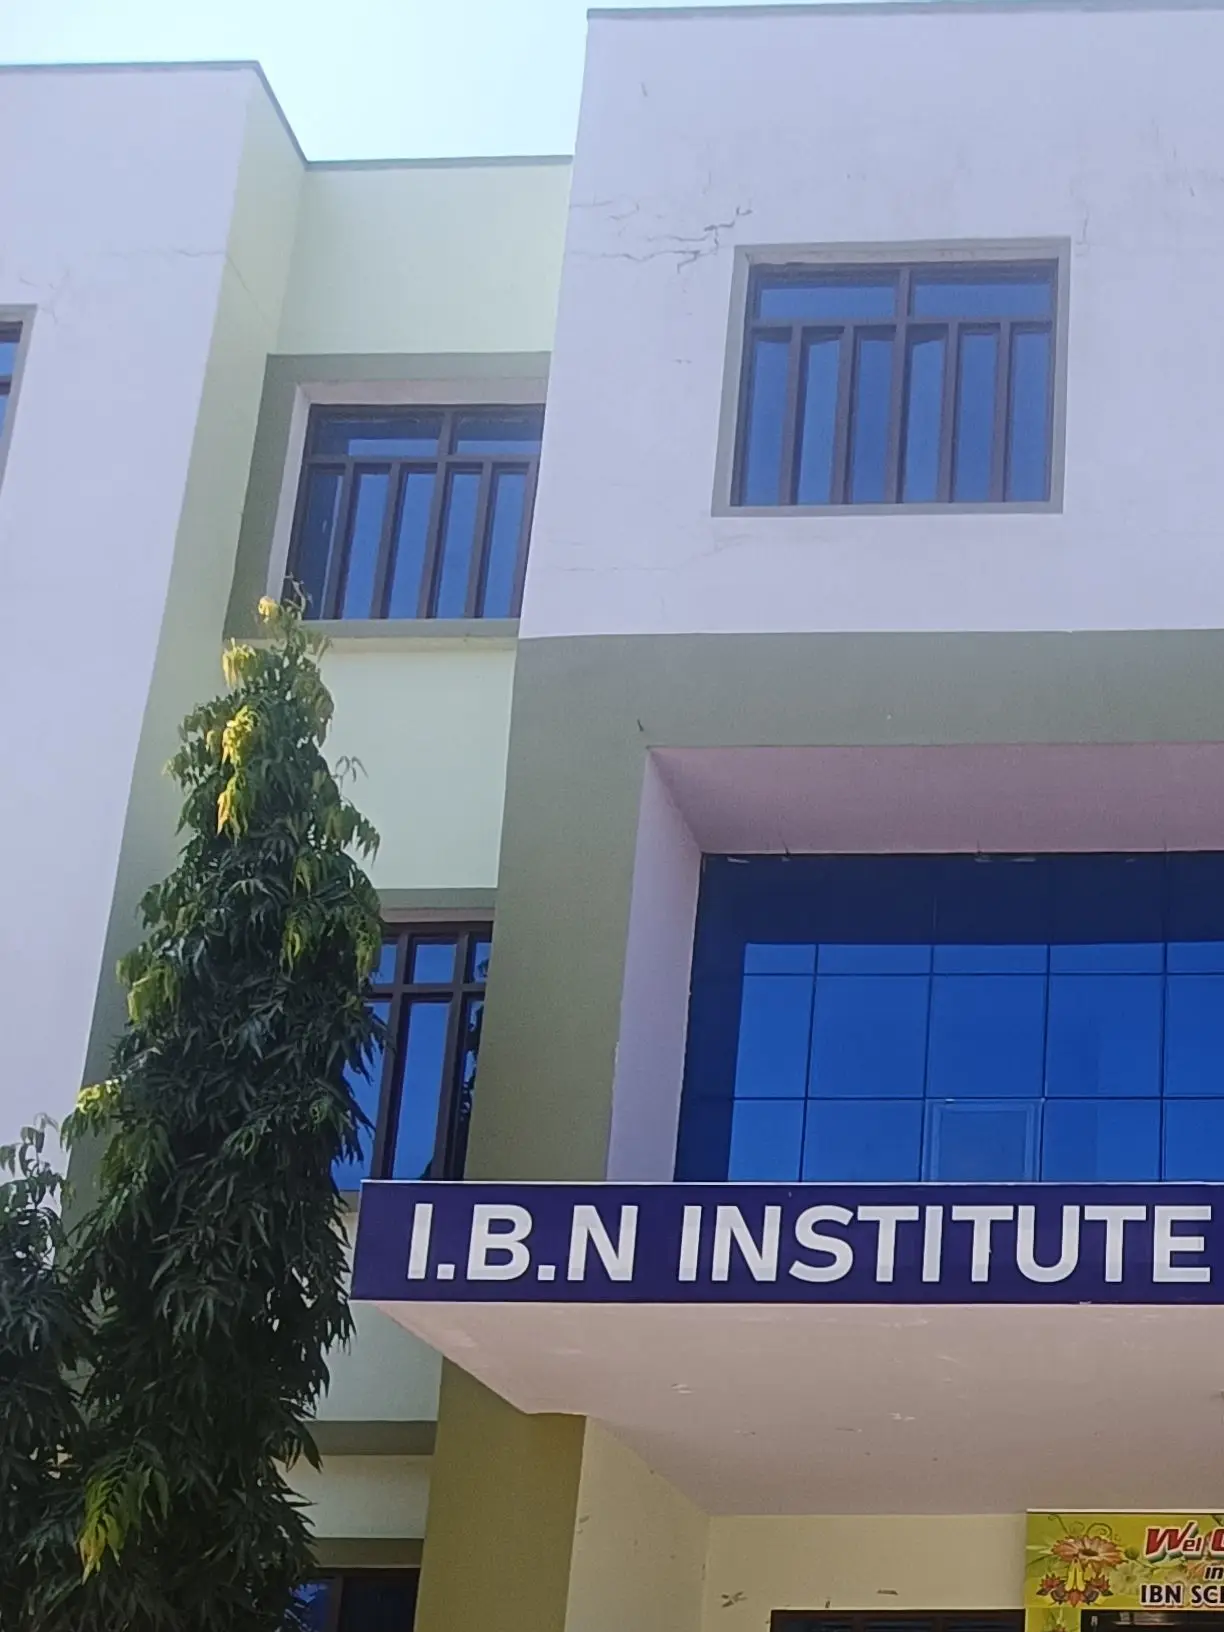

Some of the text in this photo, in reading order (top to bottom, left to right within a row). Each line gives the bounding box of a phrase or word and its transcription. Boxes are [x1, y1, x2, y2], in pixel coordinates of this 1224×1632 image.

[407, 1202, 638, 1283] I.B.N
[678, 1204, 1212, 1283] INSTITUTE
[1141, 1584, 1182, 1604] IBN
